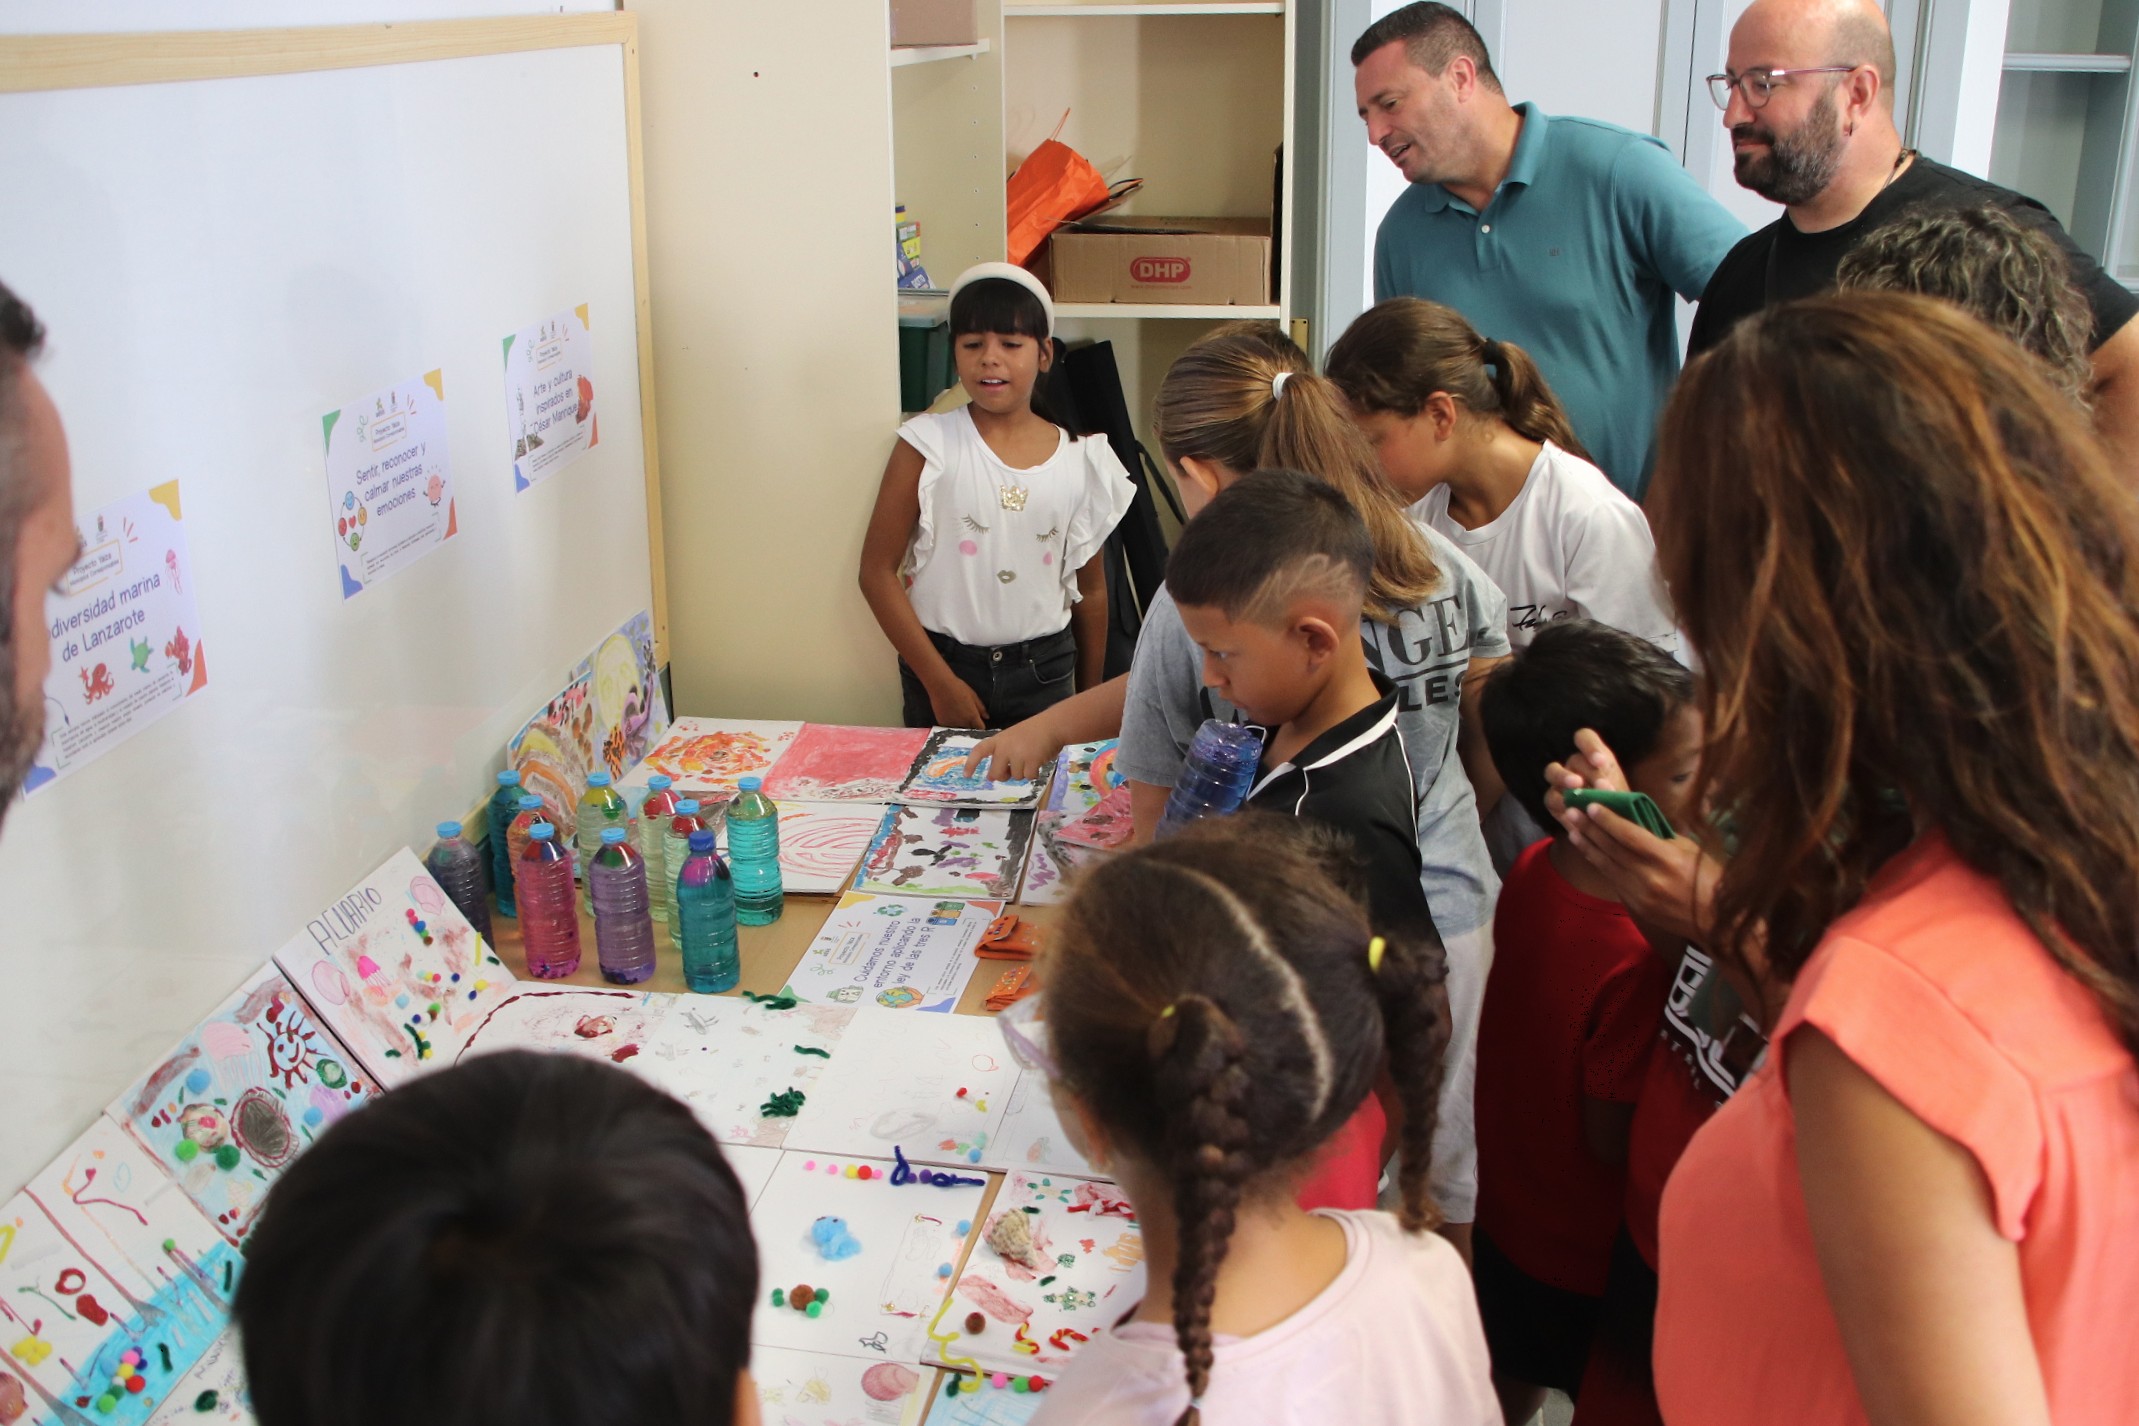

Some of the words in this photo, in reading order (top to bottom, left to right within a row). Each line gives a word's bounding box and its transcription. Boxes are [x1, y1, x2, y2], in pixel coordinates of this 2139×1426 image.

[1140, 262, 1184, 278] DHP
[534, 383, 546, 398] Arte
[553, 369, 573, 387] cultura
[536, 392, 565, 415] inspirados
[552, 403, 578, 424] Manrique
[382, 446, 418, 472] reconocer
[420, 441, 426, 456] y
[364, 481, 389, 502] calmar
[392, 464, 423, 488] nuestras
[376, 487, 416, 516] emociones
[48, 589, 116, 640] diversidad
[119, 574, 160, 605] marina
[62, 641, 79, 662] de
[82, 609, 145, 652] Lanzarote
[306, 887, 382, 955] ACUARIO
[853, 947, 885, 982] Cuidamos
[879, 920, 901, 946] nuestro
[905, 950, 922, 960] las
[913, 934, 931, 947] tres
[873, 960, 897, 988] entorno
[890, 926, 917, 958] aplicando
[899, 962, 915, 971] de
[891, 973, 911, 984] ley
